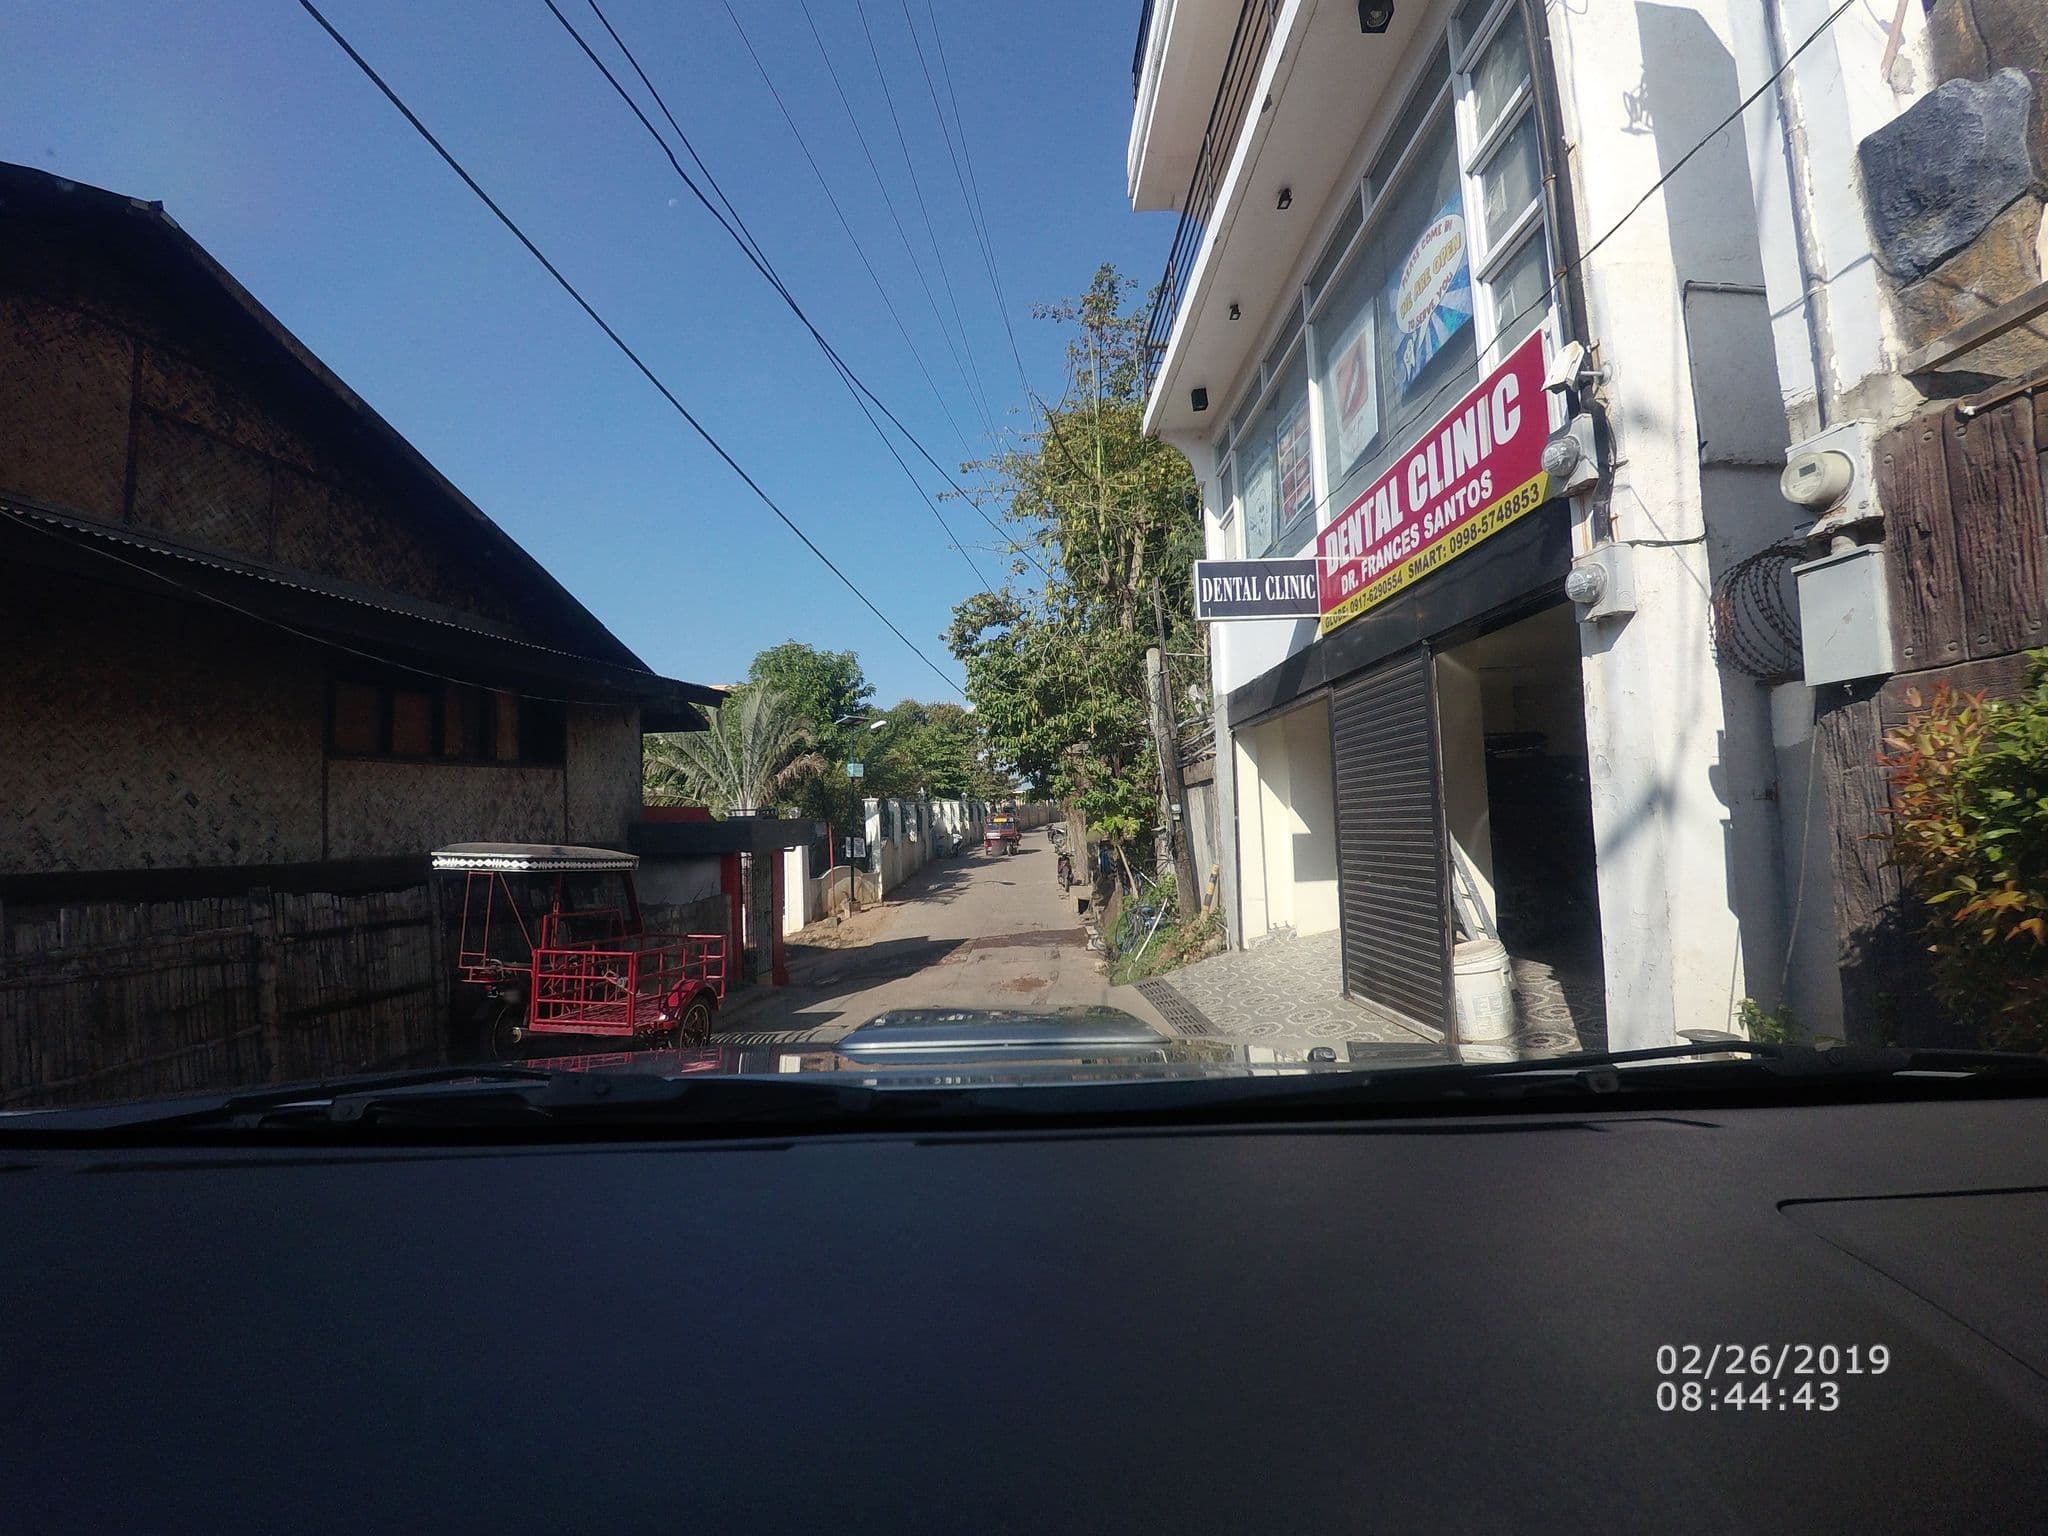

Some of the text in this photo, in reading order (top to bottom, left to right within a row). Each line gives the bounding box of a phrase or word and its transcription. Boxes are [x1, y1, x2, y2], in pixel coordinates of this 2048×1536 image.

[1413, 266, 1431, 302] ARE
[1432, 231, 1462, 275] OPEN
[1421, 223, 1442, 250] COME
[1443, 219, 1454, 234] IN
[1407, 271, 1454, 332] TO SERVE YOU
[1325, 373, 1521, 578] DENTAL CLINIC
[1341, 468, 1494, 596] DR. FRANCES SANTOS
[1350, 569, 1403, 614] 0917-6290554
[1408, 545, 1447, 579] SMART:
[1450, 482, 1539, 554] 0998-5748853
[1202, 574, 1316, 603] DENTAL CLINIC
